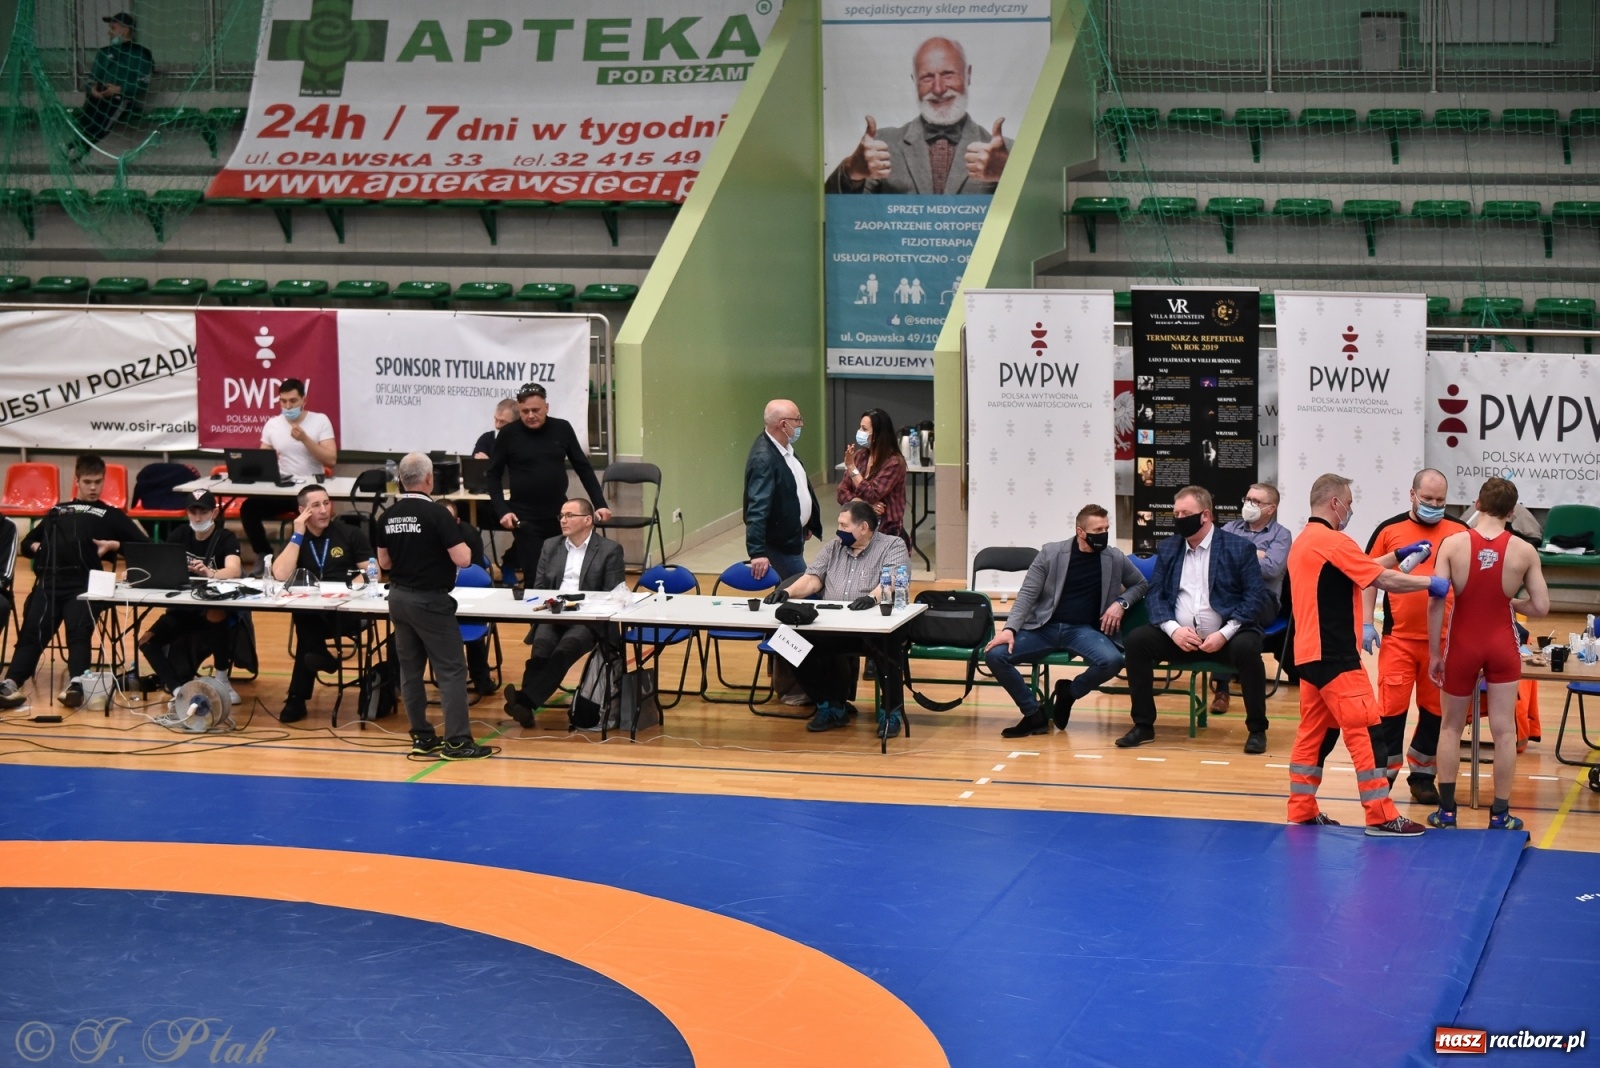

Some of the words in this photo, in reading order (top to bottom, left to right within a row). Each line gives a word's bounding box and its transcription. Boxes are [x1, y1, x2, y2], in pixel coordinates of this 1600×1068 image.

[844, 3, 933, 18] specjalistyczny
[934, 2, 966, 16] sklep
[968, 2, 1029, 16] medyczny
[396, 14, 762, 62] APTEKA
[607, 69, 655, 84] POD
[256, 103, 367, 139] 24h
[532, 123, 567, 140] w
[444, 153, 483, 167] 33
[596, 151, 655, 167] 415
[662, 150, 702, 165] 49
[887, 205, 925, 215] SPRZĘT
[926, 205, 988, 215] MEDYCZNY
[854, 221, 932, 231] ZAOPATRZENIE
[901, 237, 974, 247] FIZJOTERAPIA
[833, 253, 871, 263] USŁUGI
[872, 254, 949, 264] PROTETYCZNO
[840, 331, 854, 342] ul.
[855, 331, 905, 344] Opawska
[1145, 334, 1191, 343] TERMINARZ
[1200, 335, 1245, 343] REPERTUAR
[1171, 343, 1183, 351] NA
[1184, 343, 1201, 351] ROK
[1201, 343, 1220, 351] 2019
[838, 355, 928, 368] REALIZUJEMY
[375, 356, 441, 377] SPONSOR
[444, 359, 526, 381] TYTULARNY
[530, 363, 556, 382] PZZ
[1000, 362, 1080, 388] PWPW
[1309, 365, 1391, 394] PWPW
[58, 379, 81, 403] W
[224, 377, 311, 410] PWP
[375, 383, 411, 394] OFICJALNY
[413, 385, 446, 396] SPONSOR
[447, 386, 500, 398] REPREZENTACJI
[1001, 392, 1031, 400] POLSKA
[1031, 391, 1079, 400] WYTWÓRNIA
[375, 395, 384, 405] W
[384, 395, 422, 406] ZAPASACH
[987, 400, 1025, 409] PAPIERÓW
[1025, 400, 1093, 409] WARTOŚCIOWYCH
[1311, 396, 1340, 404] POLSKA
[1341, 396, 1389, 406] WYTWÓRNIA
[1297, 404, 1334, 413] PAPIERÓW
[1335, 404, 1403, 415] WARTOŚCIOWYCH
[226, 414, 258, 423] POLSKA
[211, 424, 253, 434] PAPIERÓW
[1482, 451, 1535, 463] POLSKA
[1456, 465, 1525, 479] PAPIERÓW
[1528, 467, 1600, 481] WARTOŚCI
[385, 524, 421, 534] WRESTLING
